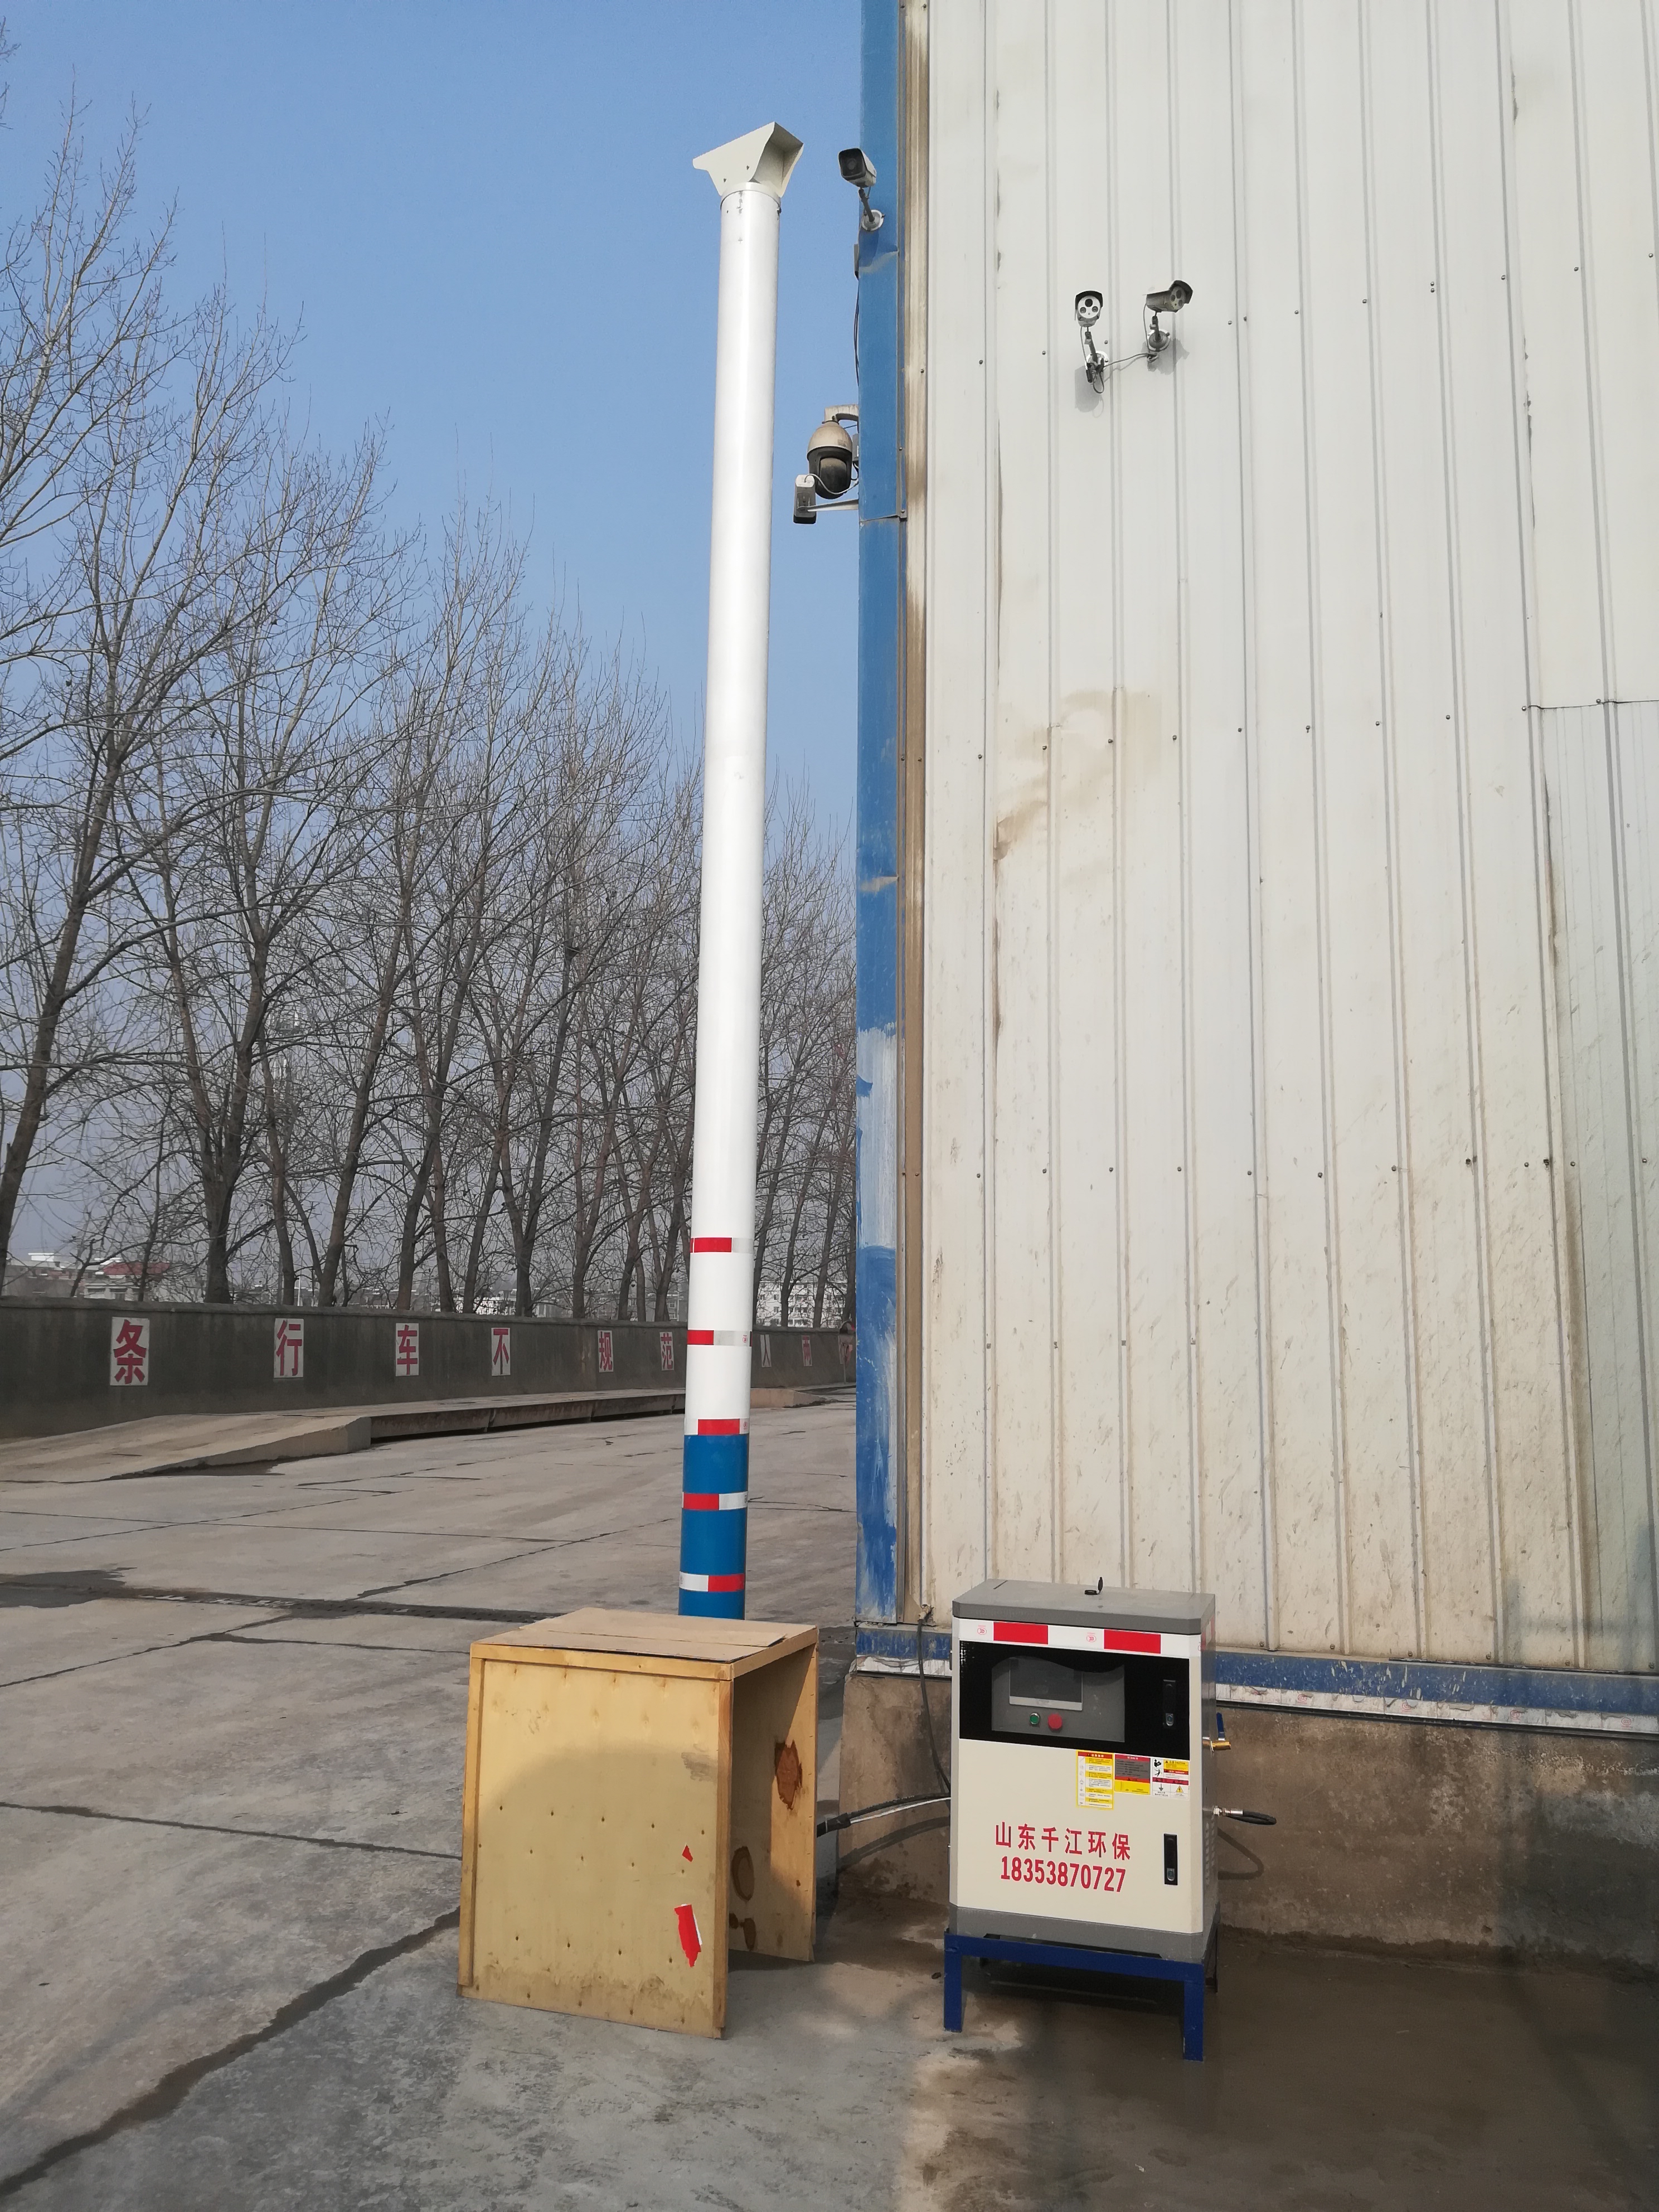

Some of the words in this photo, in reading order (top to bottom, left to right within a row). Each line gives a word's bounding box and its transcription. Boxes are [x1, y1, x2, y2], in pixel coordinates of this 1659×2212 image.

[113, 1320, 146, 1384] 条
[276, 1320, 302, 1376] 行
[397, 1325, 418, 1375] 车
[494, 1328, 508, 1375] 不
[599, 1332, 612, 1371] 规
[661, 1333, 673, 1369] 范
[996, 1821, 1131, 1860] 山东千江环保
[1001, 1856, 1126, 1893] 18353870727
